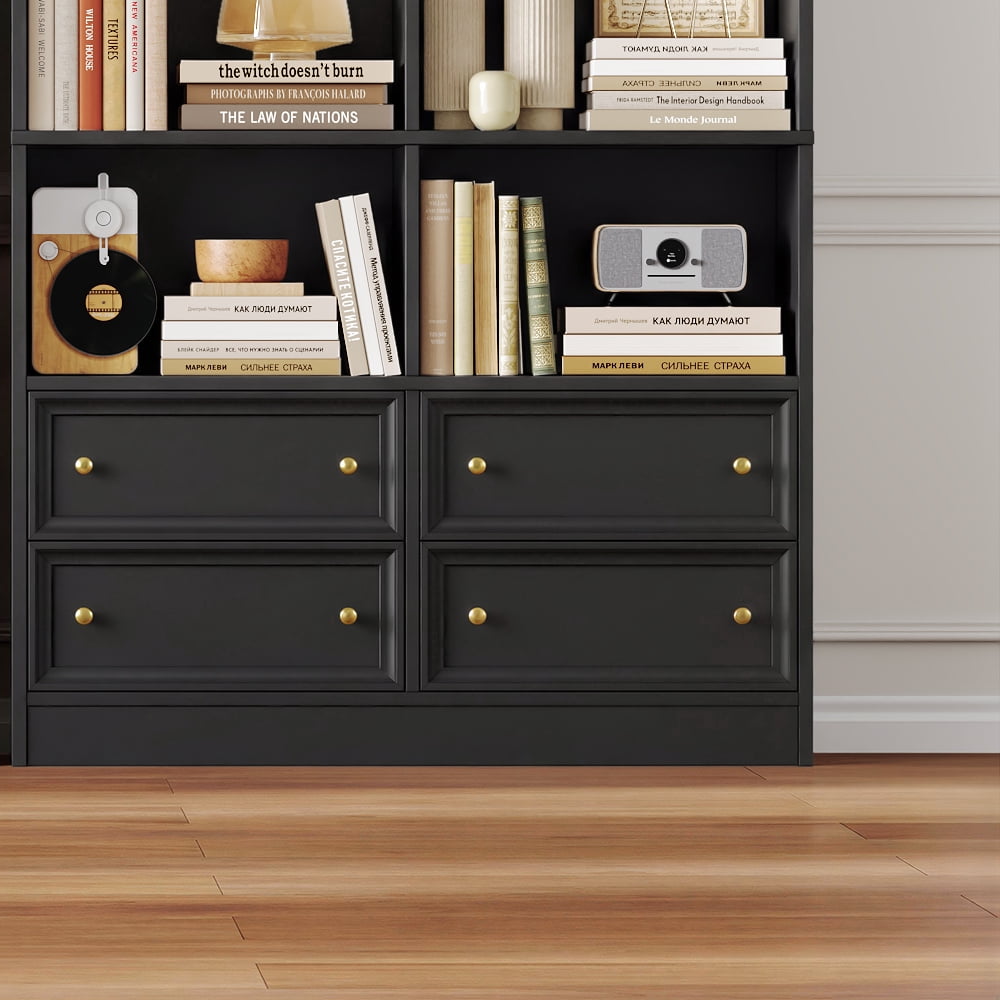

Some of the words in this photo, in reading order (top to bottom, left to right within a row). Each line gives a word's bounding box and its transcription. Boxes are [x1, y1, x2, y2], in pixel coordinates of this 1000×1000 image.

[85, 9, 94, 40] WILTON
[108, 19, 118, 60] TEXTURES
[85, 44, 94, 71] HOUSE
[219, 63, 241, 78] the
[242, 63, 279, 78] witch
[332, 63, 363, 78] burn
[699, 96, 724, 106] Design
[220, 111, 245, 123] THE
[251, 111, 276, 123] LAW
[281, 111, 298, 123] OF
[303, 111, 358, 123] NATIONS
[700, 116, 737, 124] Journal
[370, 258, 380, 280] Метод
[331, 239, 351, 289] СПАСИТЕ
[341, 293, 360, 342] КОТИКА!
[653, 317, 672, 326] КАК
[674, 317, 705, 326] ЛЮДИ
[707, 317, 750, 326] ДУМАЮТ
[592, 362, 618, 370] МАРК
[618, 362, 644, 370] ЛЕВИ
[661, 362, 709, 370] СИЛЬНЕЕ
[714, 362, 751, 370] СТРАХА
